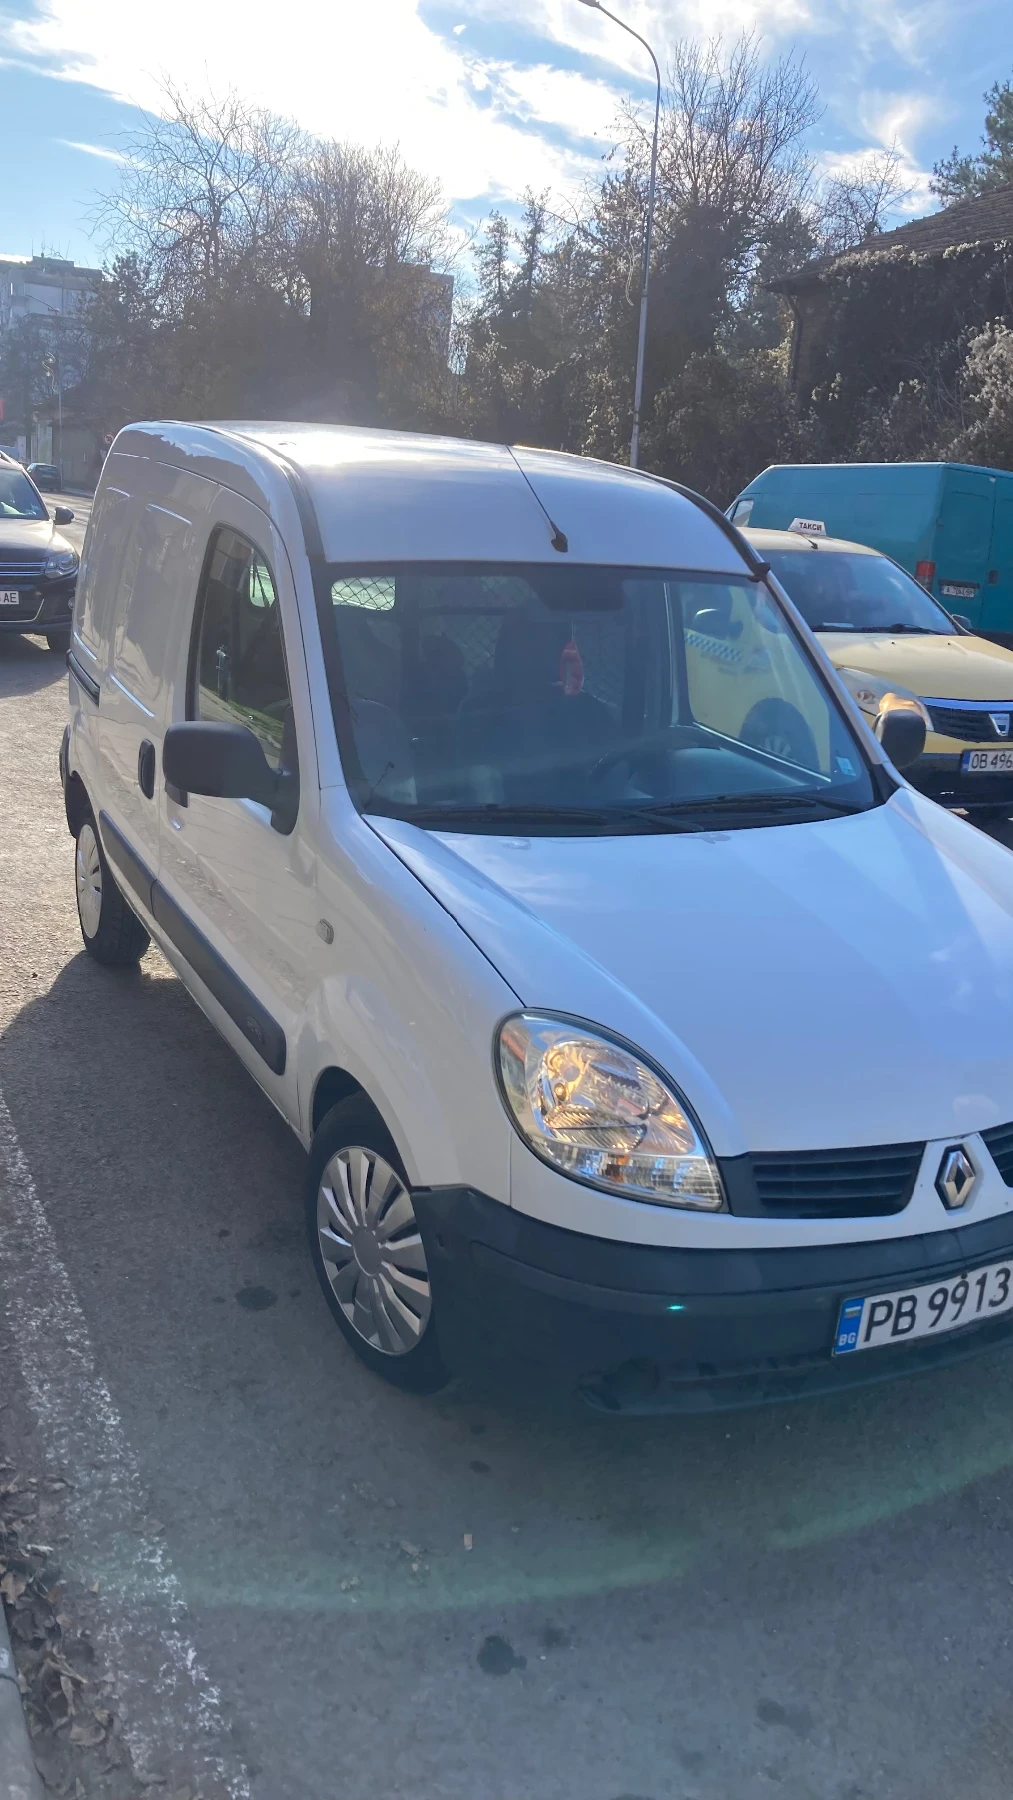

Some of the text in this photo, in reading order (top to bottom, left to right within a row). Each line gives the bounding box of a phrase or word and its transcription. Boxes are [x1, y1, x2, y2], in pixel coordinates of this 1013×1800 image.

[799, 521, 822, 531] ТАКСИ
[3, 592, 17, 603] AE
[863, 1267, 1011, 1342] PB 9913
[838, 1332, 856, 1346] BG
